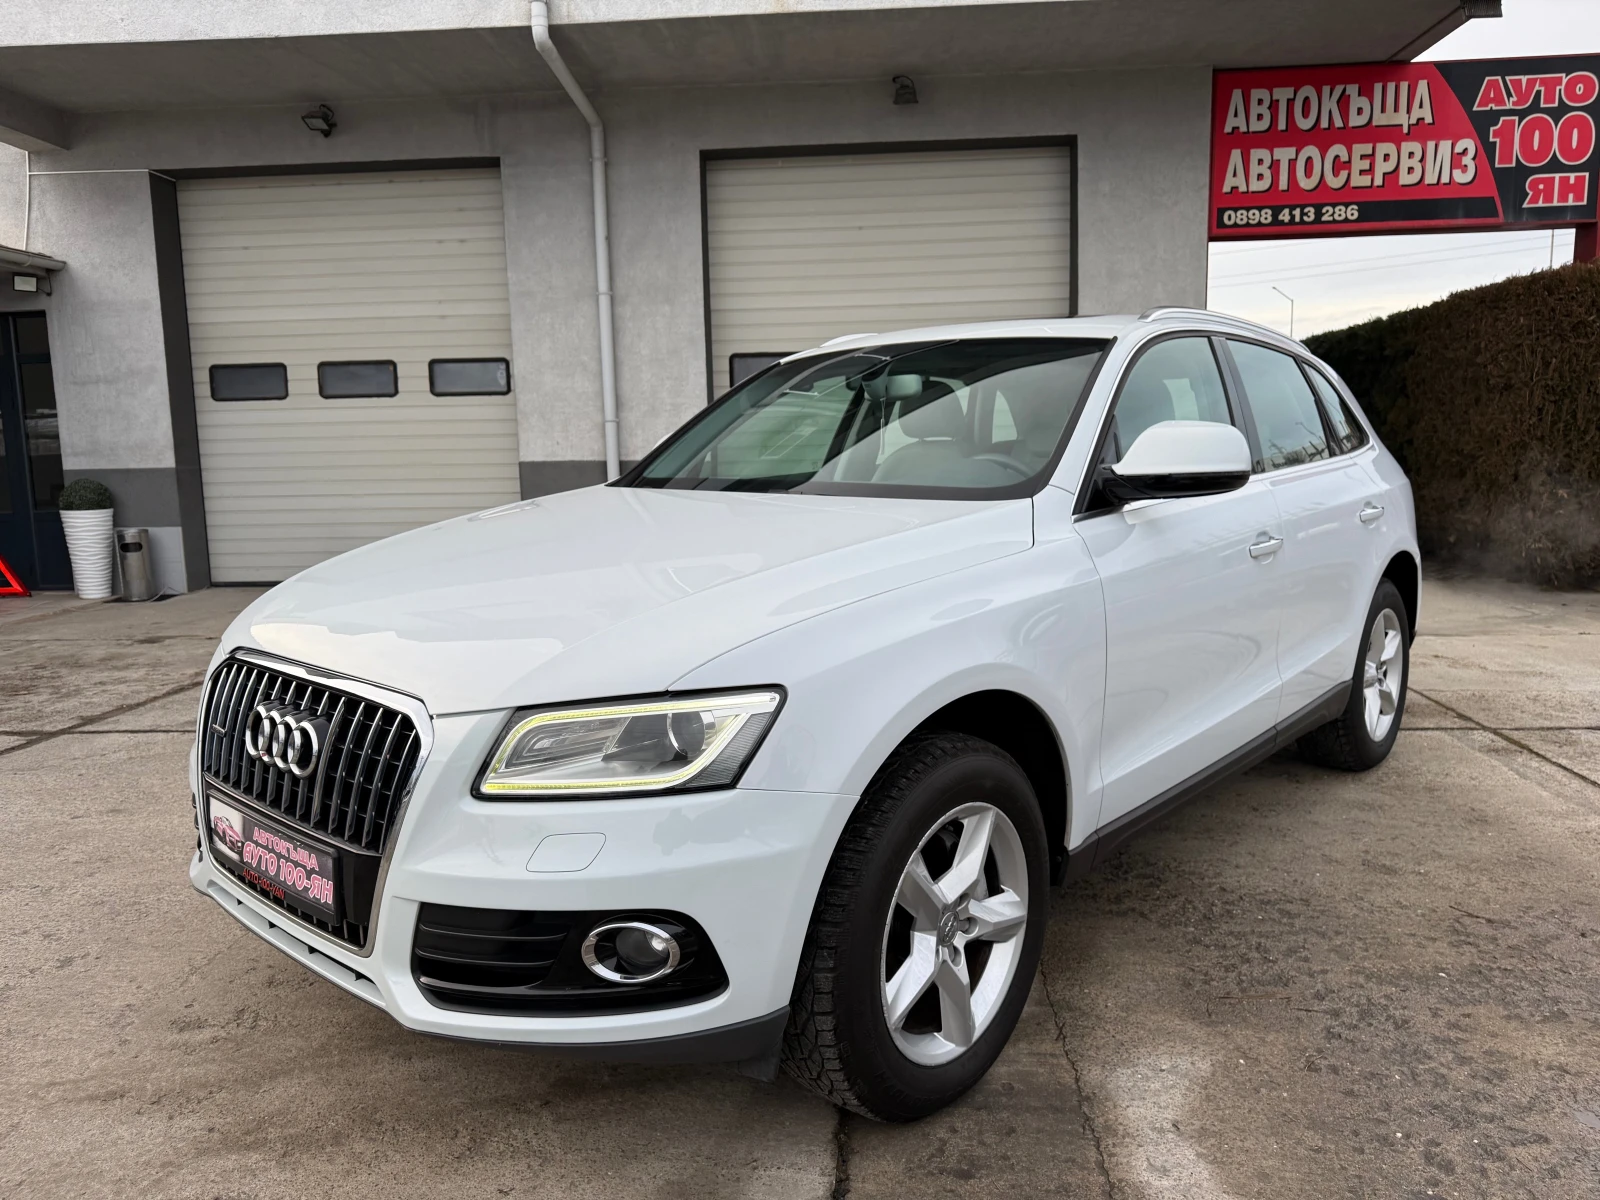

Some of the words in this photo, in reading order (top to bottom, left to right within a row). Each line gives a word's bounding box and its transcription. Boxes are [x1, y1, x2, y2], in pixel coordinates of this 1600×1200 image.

[1223, 79, 1434, 134] АВТОКЪЩА
[1472, 72, 1599, 111] АУТО
[1489, 111, 1596, 168] 100
[1222, 138, 1477, 194] АВТОСЕРВИЗ
[1522, 172, 1590, 208] ЯН
[1223, 208, 1273, 226] 0898
[1278, 206, 1315, 223] 413
[1321, 205, 1359, 222] 286
[243, 841, 278, 875] АУТО
[280, 859, 334, 904] 100-ЯН
[253, 827, 319, 871] АВТОКЪЩА
